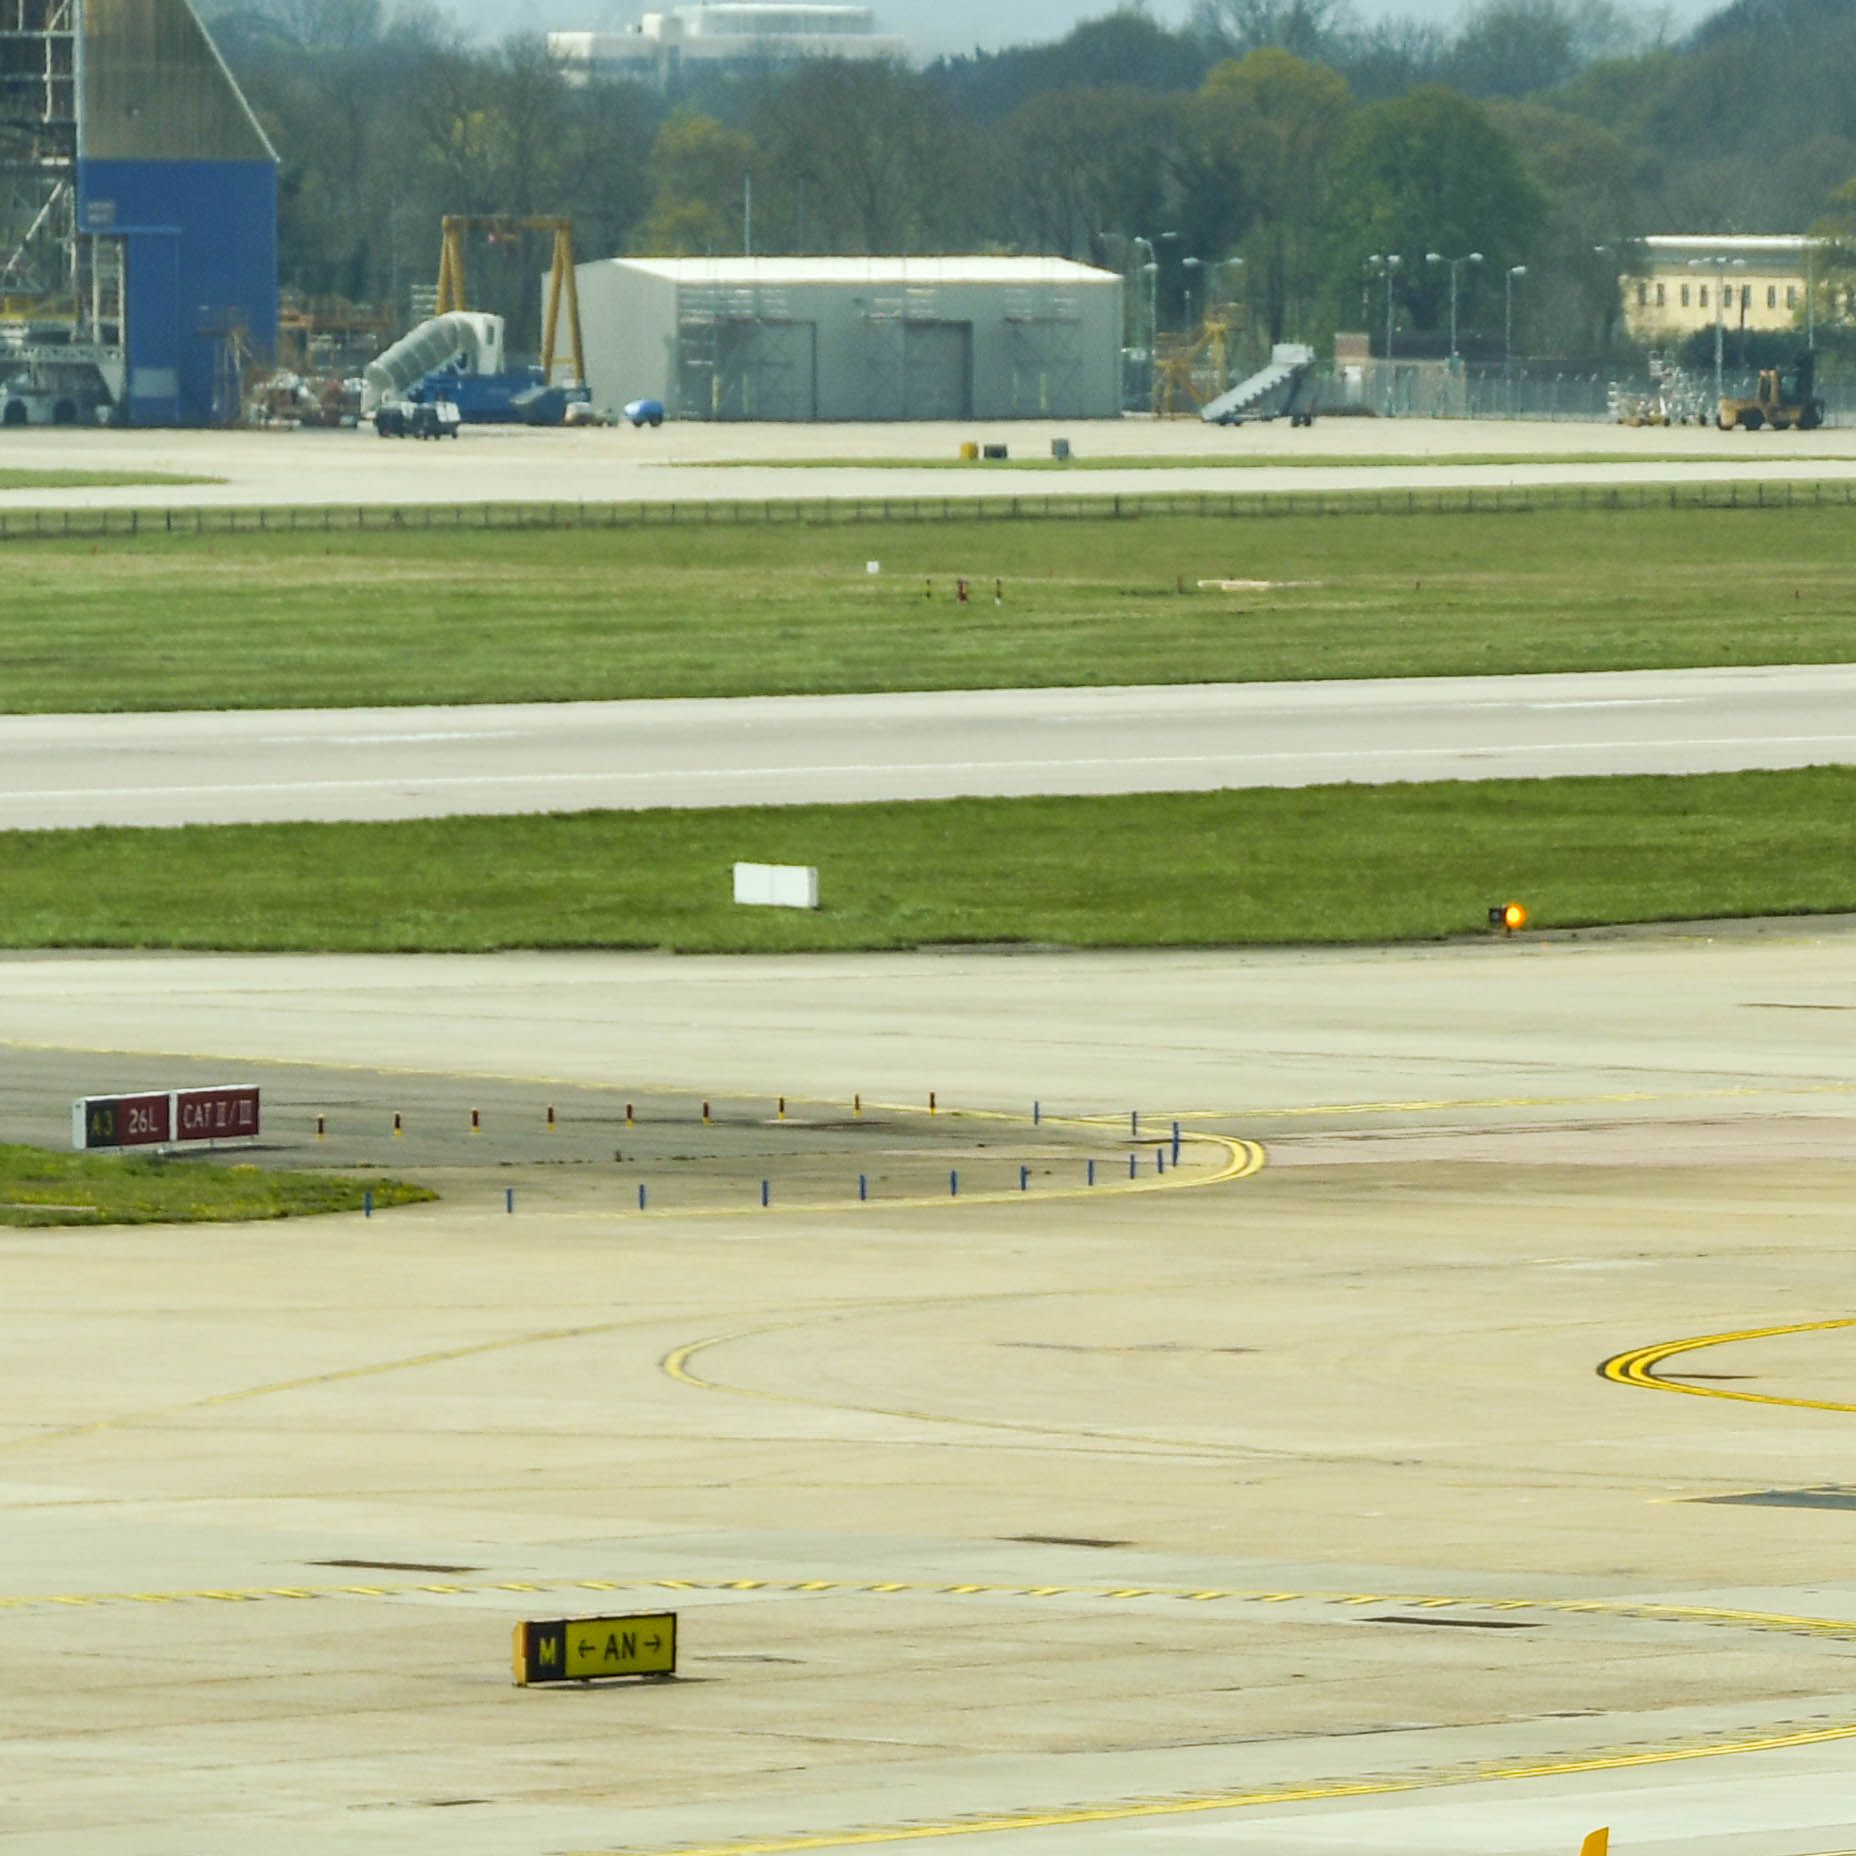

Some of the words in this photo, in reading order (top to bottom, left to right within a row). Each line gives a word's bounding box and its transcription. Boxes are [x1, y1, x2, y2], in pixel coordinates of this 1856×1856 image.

[128, 1106, 159, 1134] 26L
[183, 1102, 213, 1129] CAT
[538, 1636, 557, 1665] M
[604, 1631, 638, 1661] AN
